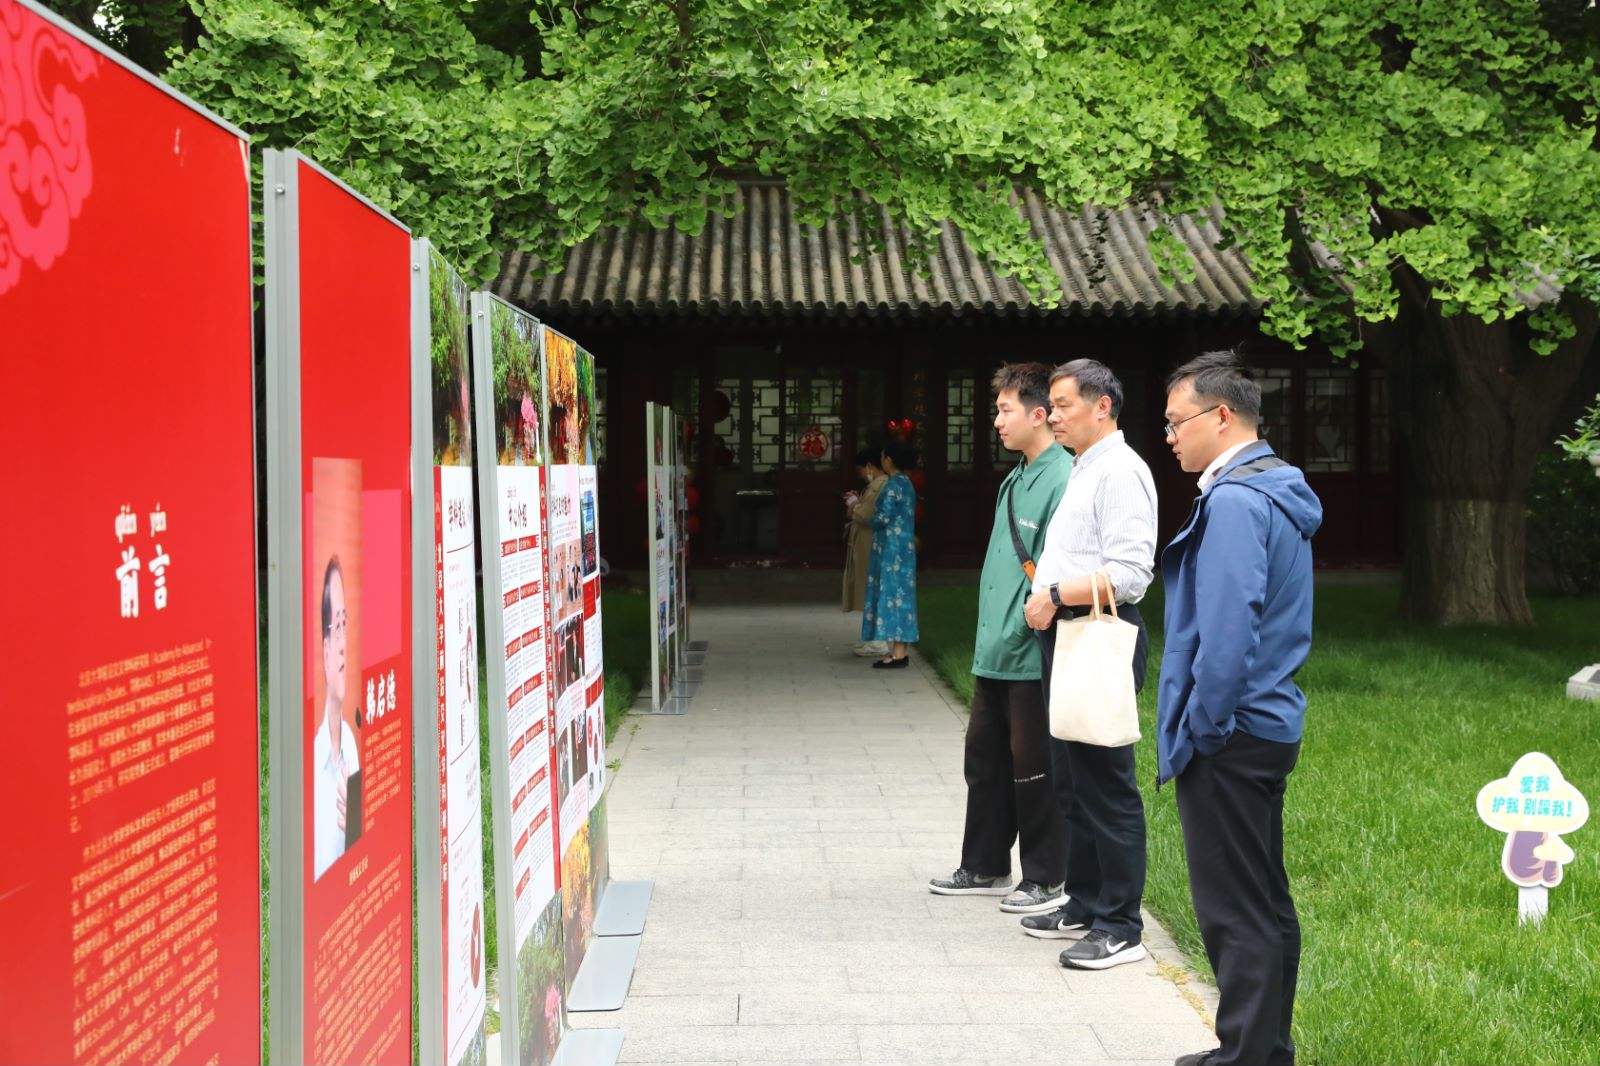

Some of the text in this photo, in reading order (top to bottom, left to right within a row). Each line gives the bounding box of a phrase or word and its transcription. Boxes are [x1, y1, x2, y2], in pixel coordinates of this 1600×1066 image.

[115, 544, 171, 618] 前言
[366, 669, 396, 725] 韩启德
[1519, 776, 1550, 793] 爱我
[1492, 796, 1519, 814] 护我
